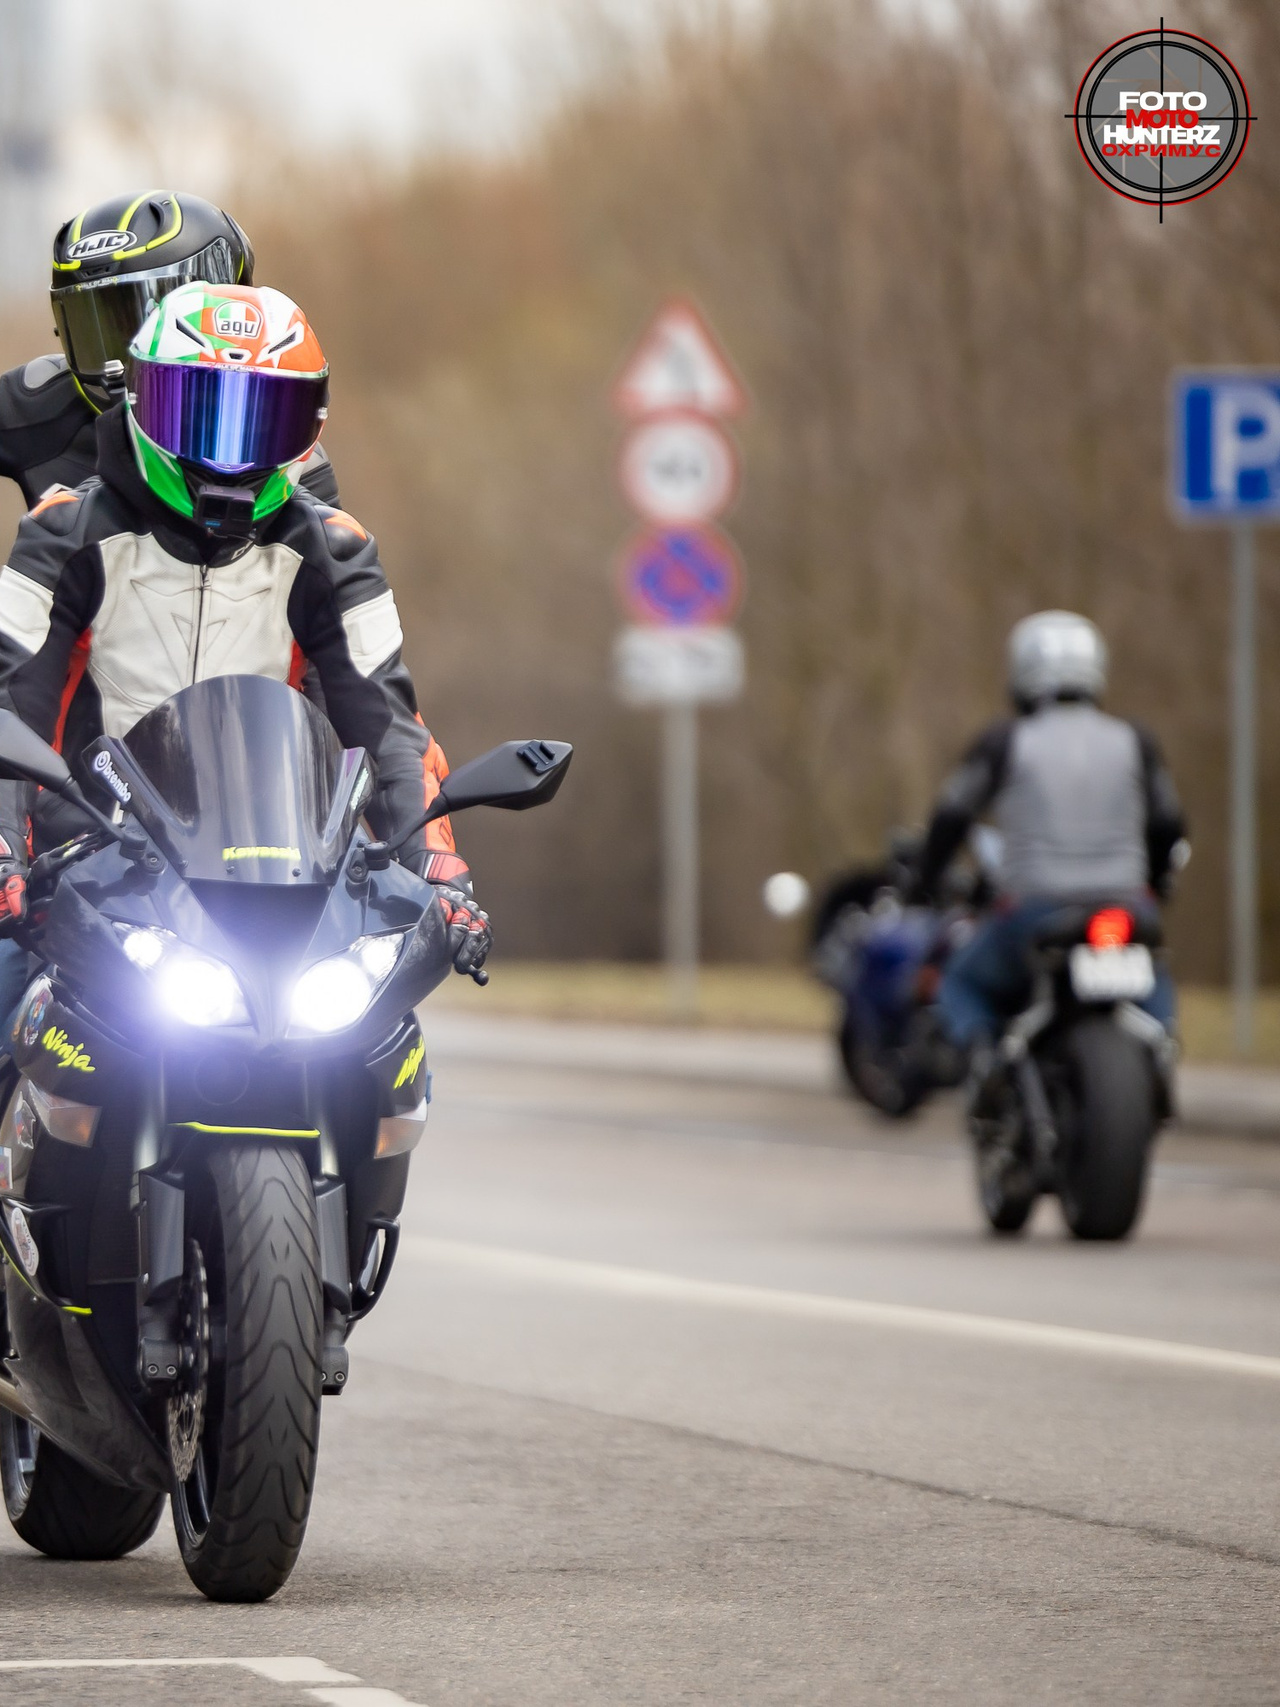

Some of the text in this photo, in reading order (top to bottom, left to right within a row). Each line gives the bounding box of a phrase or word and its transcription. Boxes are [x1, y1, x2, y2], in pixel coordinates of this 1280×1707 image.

[72, 234, 125, 256] HJC
[220, 320, 255, 336] agv
[1212, 387, 1280, 502] P
[102, 761, 132, 802] brembo
[222, 846, 302, 861] Kawasaki
[42, 1026, 96, 1072] Ninja
